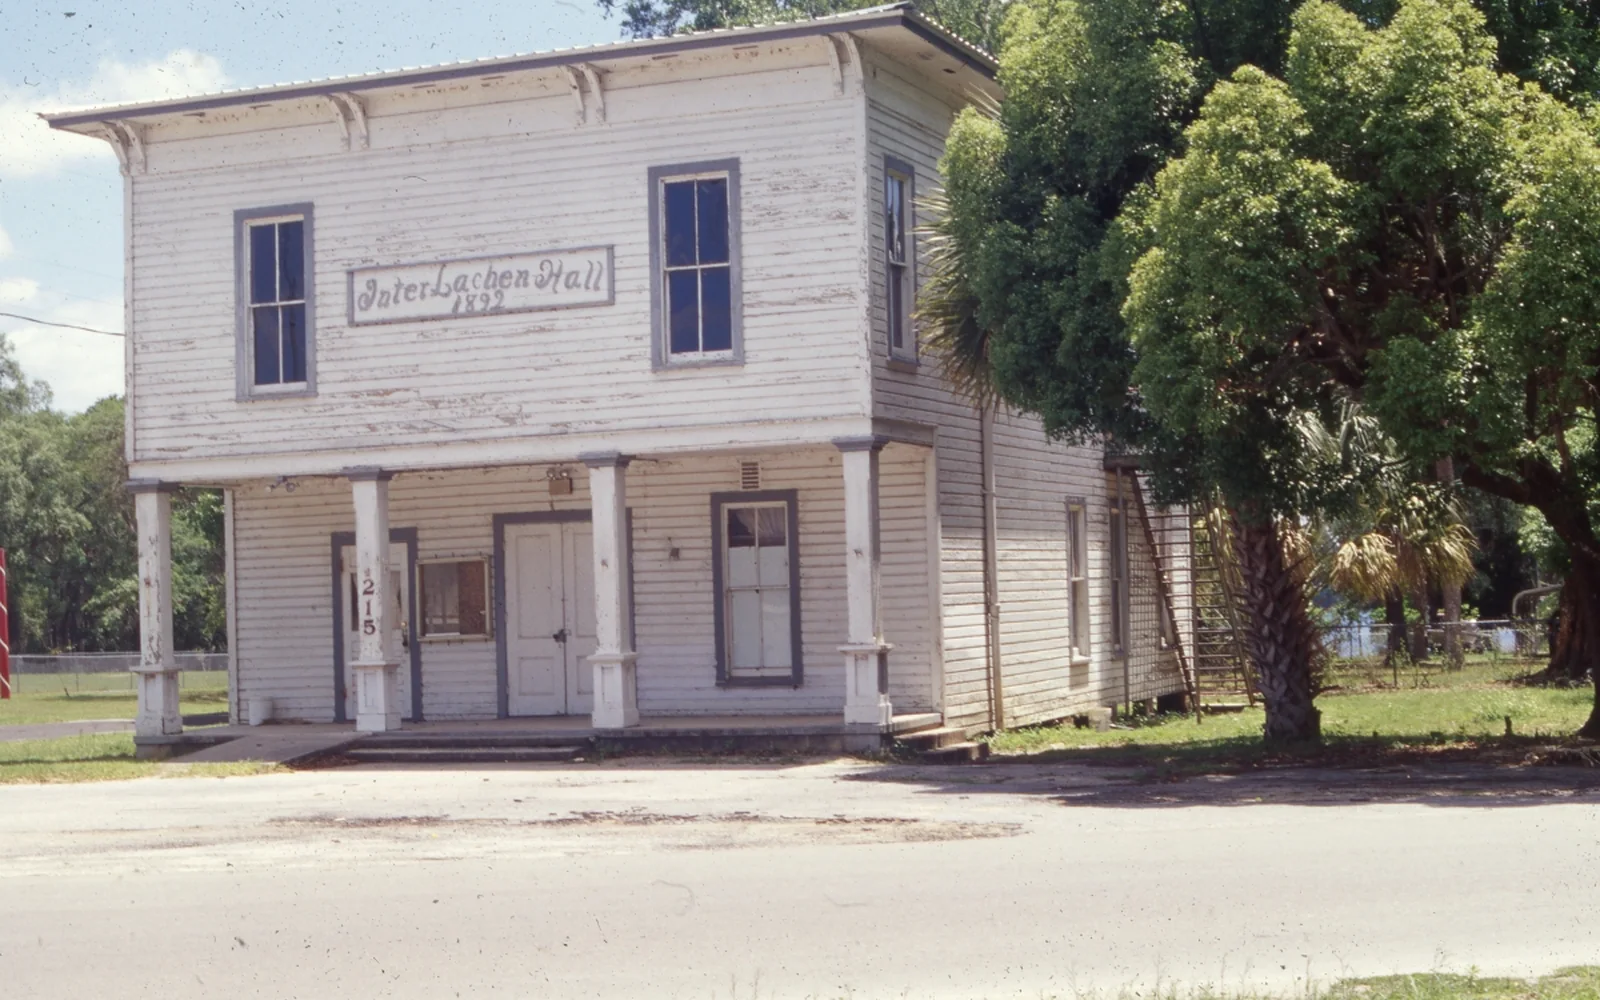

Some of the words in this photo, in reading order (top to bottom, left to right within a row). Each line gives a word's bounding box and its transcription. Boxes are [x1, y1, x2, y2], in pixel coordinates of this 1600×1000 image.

[533, 259, 604, 294] Hall
[451, 289, 506, 314] 1892
[362, 579, 376, 635] 215
